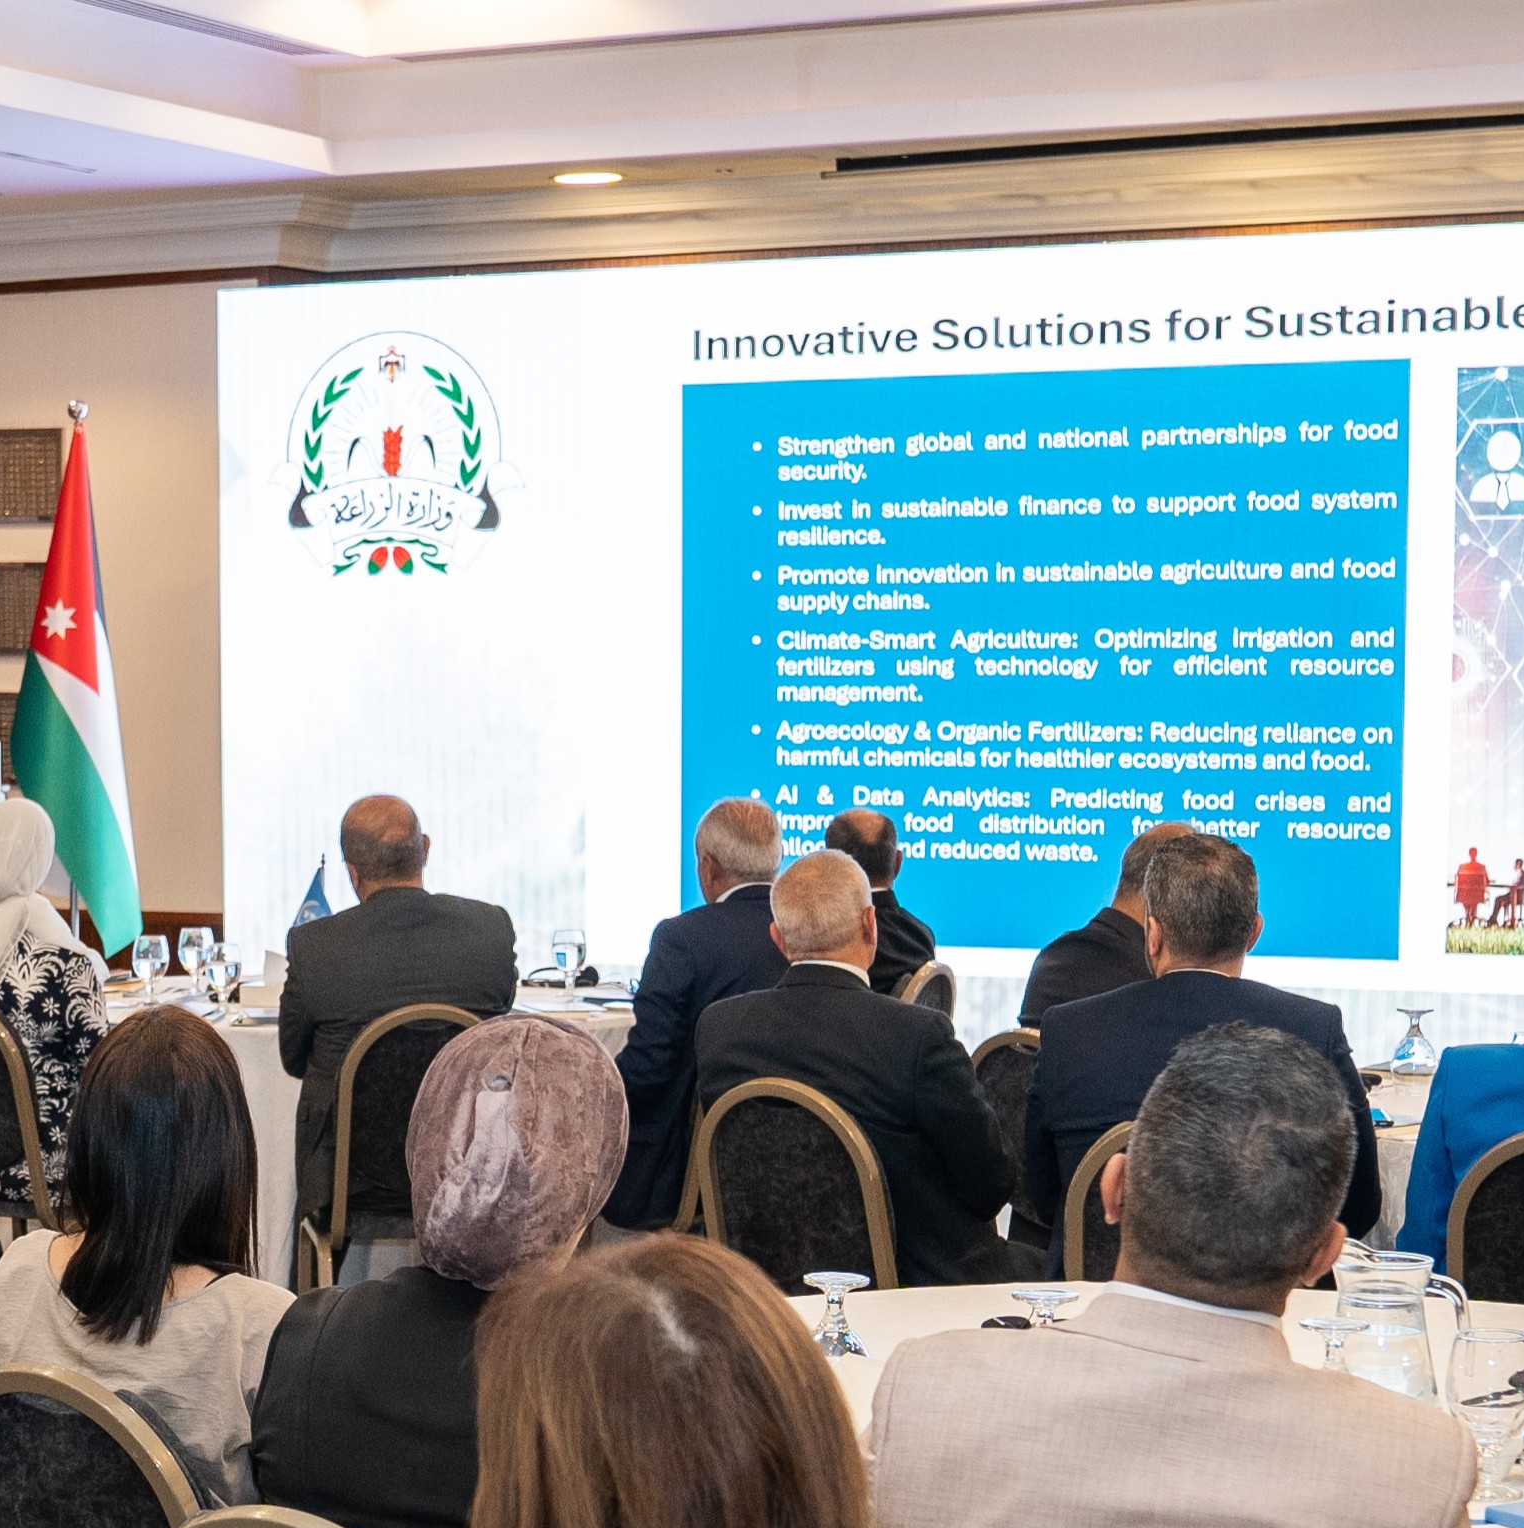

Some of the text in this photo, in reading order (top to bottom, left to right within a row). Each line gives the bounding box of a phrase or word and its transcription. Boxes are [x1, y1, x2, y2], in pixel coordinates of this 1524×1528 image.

[693, 322, 918, 361] Innovative
[931, 313, 1151, 351] Solutions
[1165, 308, 1232, 342] for
[778, 419, 1398, 459] Strengthen global and national partnerships for food
[778, 460, 867, 483] security.
[779, 490, 1397, 520] Invest in sustainable finance to support food system
[778, 526, 886, 546] resilience.
[778, 557, 1395, 585] Promote innovation in sustainable agriculture and food
[777, 590, 930, 615] supply chains.
[777, 627, 1394, 653] Climate-Smart Agriculture: Optimizing irrigation and
[776, 655, 1394, 680] fertilizers using technology for efficient resource
[777, 684, 923, 706] management.
[776, 721, 1393, 746] Agroecology & Organic Fertilizers: Reducing reliance on
[777, 746, 1370, 773] harmful chemicals for healthier ecosystems and food.
[776, 785, 1391, 814] AI & Data Analytics: Predicting food crises and
[904, 813, 953, 832] food
[979, 813, 1104, 835] distribution
[1287, 822, 1391, 841] resource
[931, 840, 1020, 861] reduced
[1025, 843, 1098, 862] waste.
